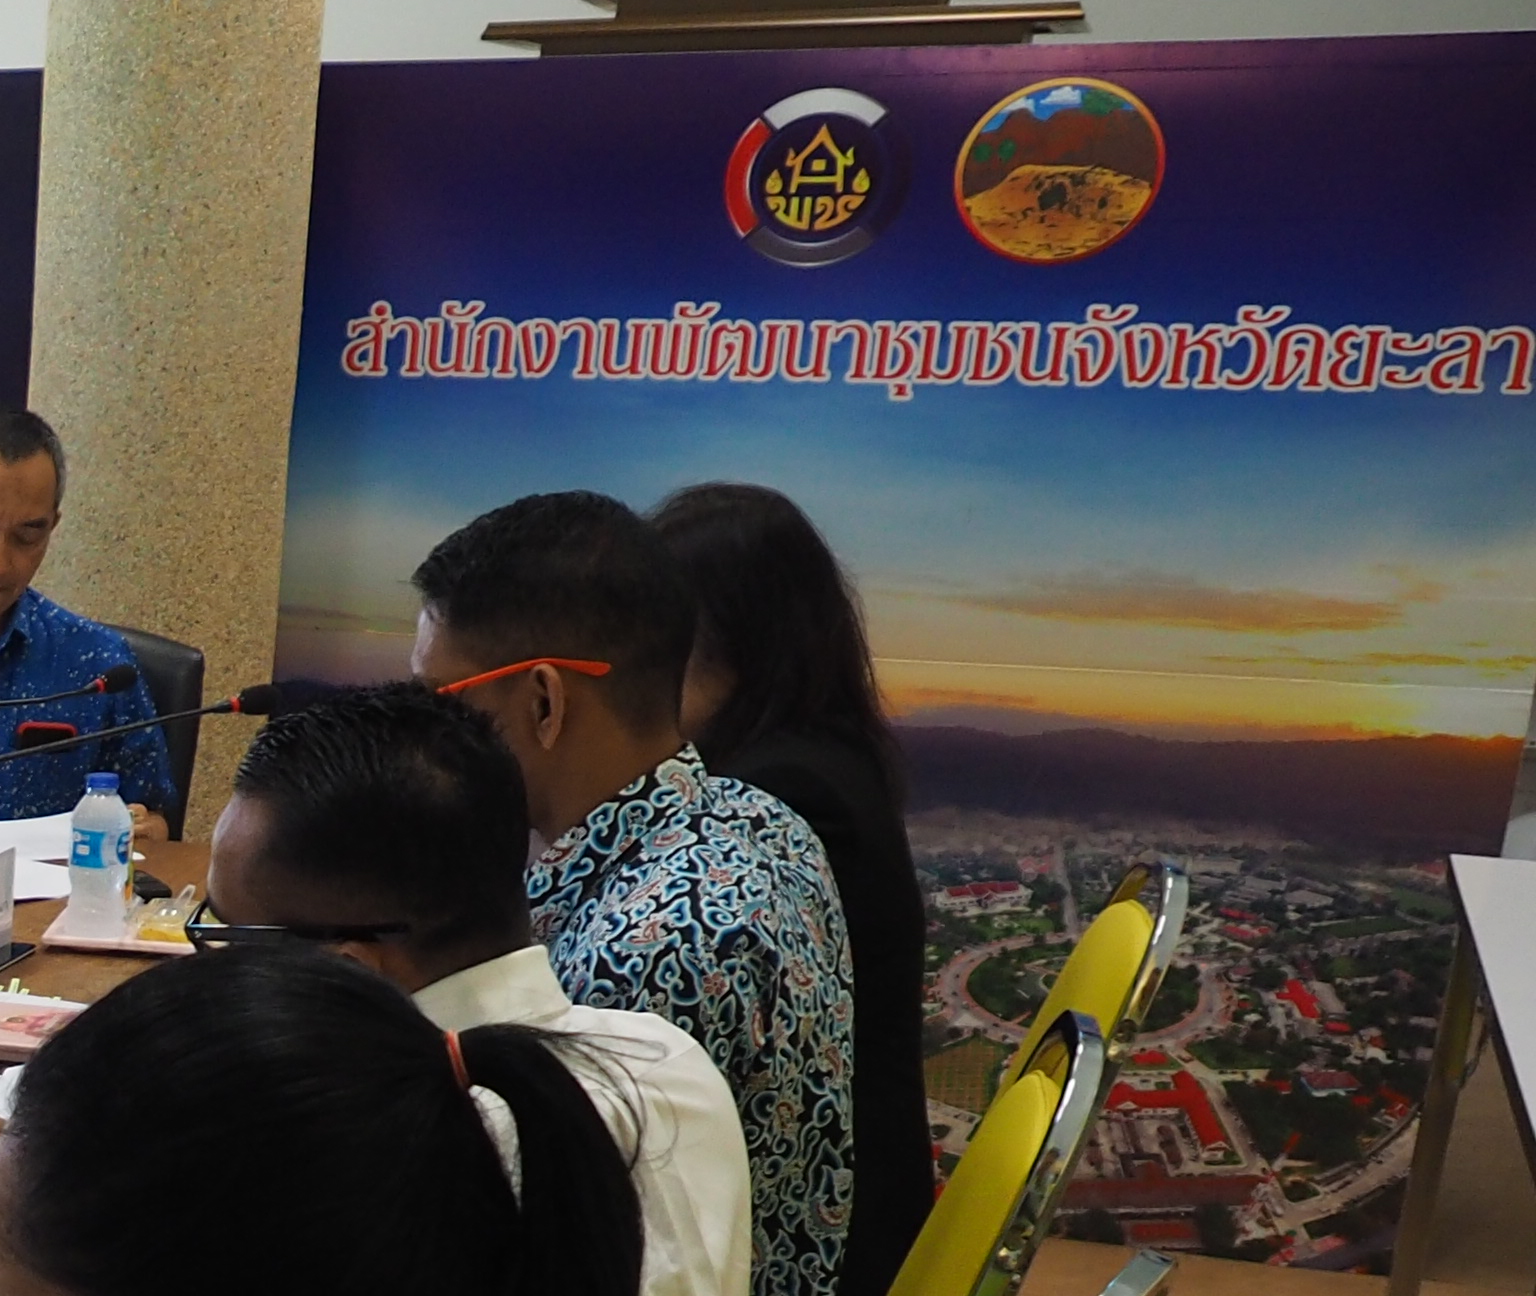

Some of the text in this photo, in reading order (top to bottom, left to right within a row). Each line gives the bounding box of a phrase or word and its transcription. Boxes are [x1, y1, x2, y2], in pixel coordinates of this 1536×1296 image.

[340, 299, 1533, 400] สำนักงานพัฒนาชุมชนจังหวัดยะลา
